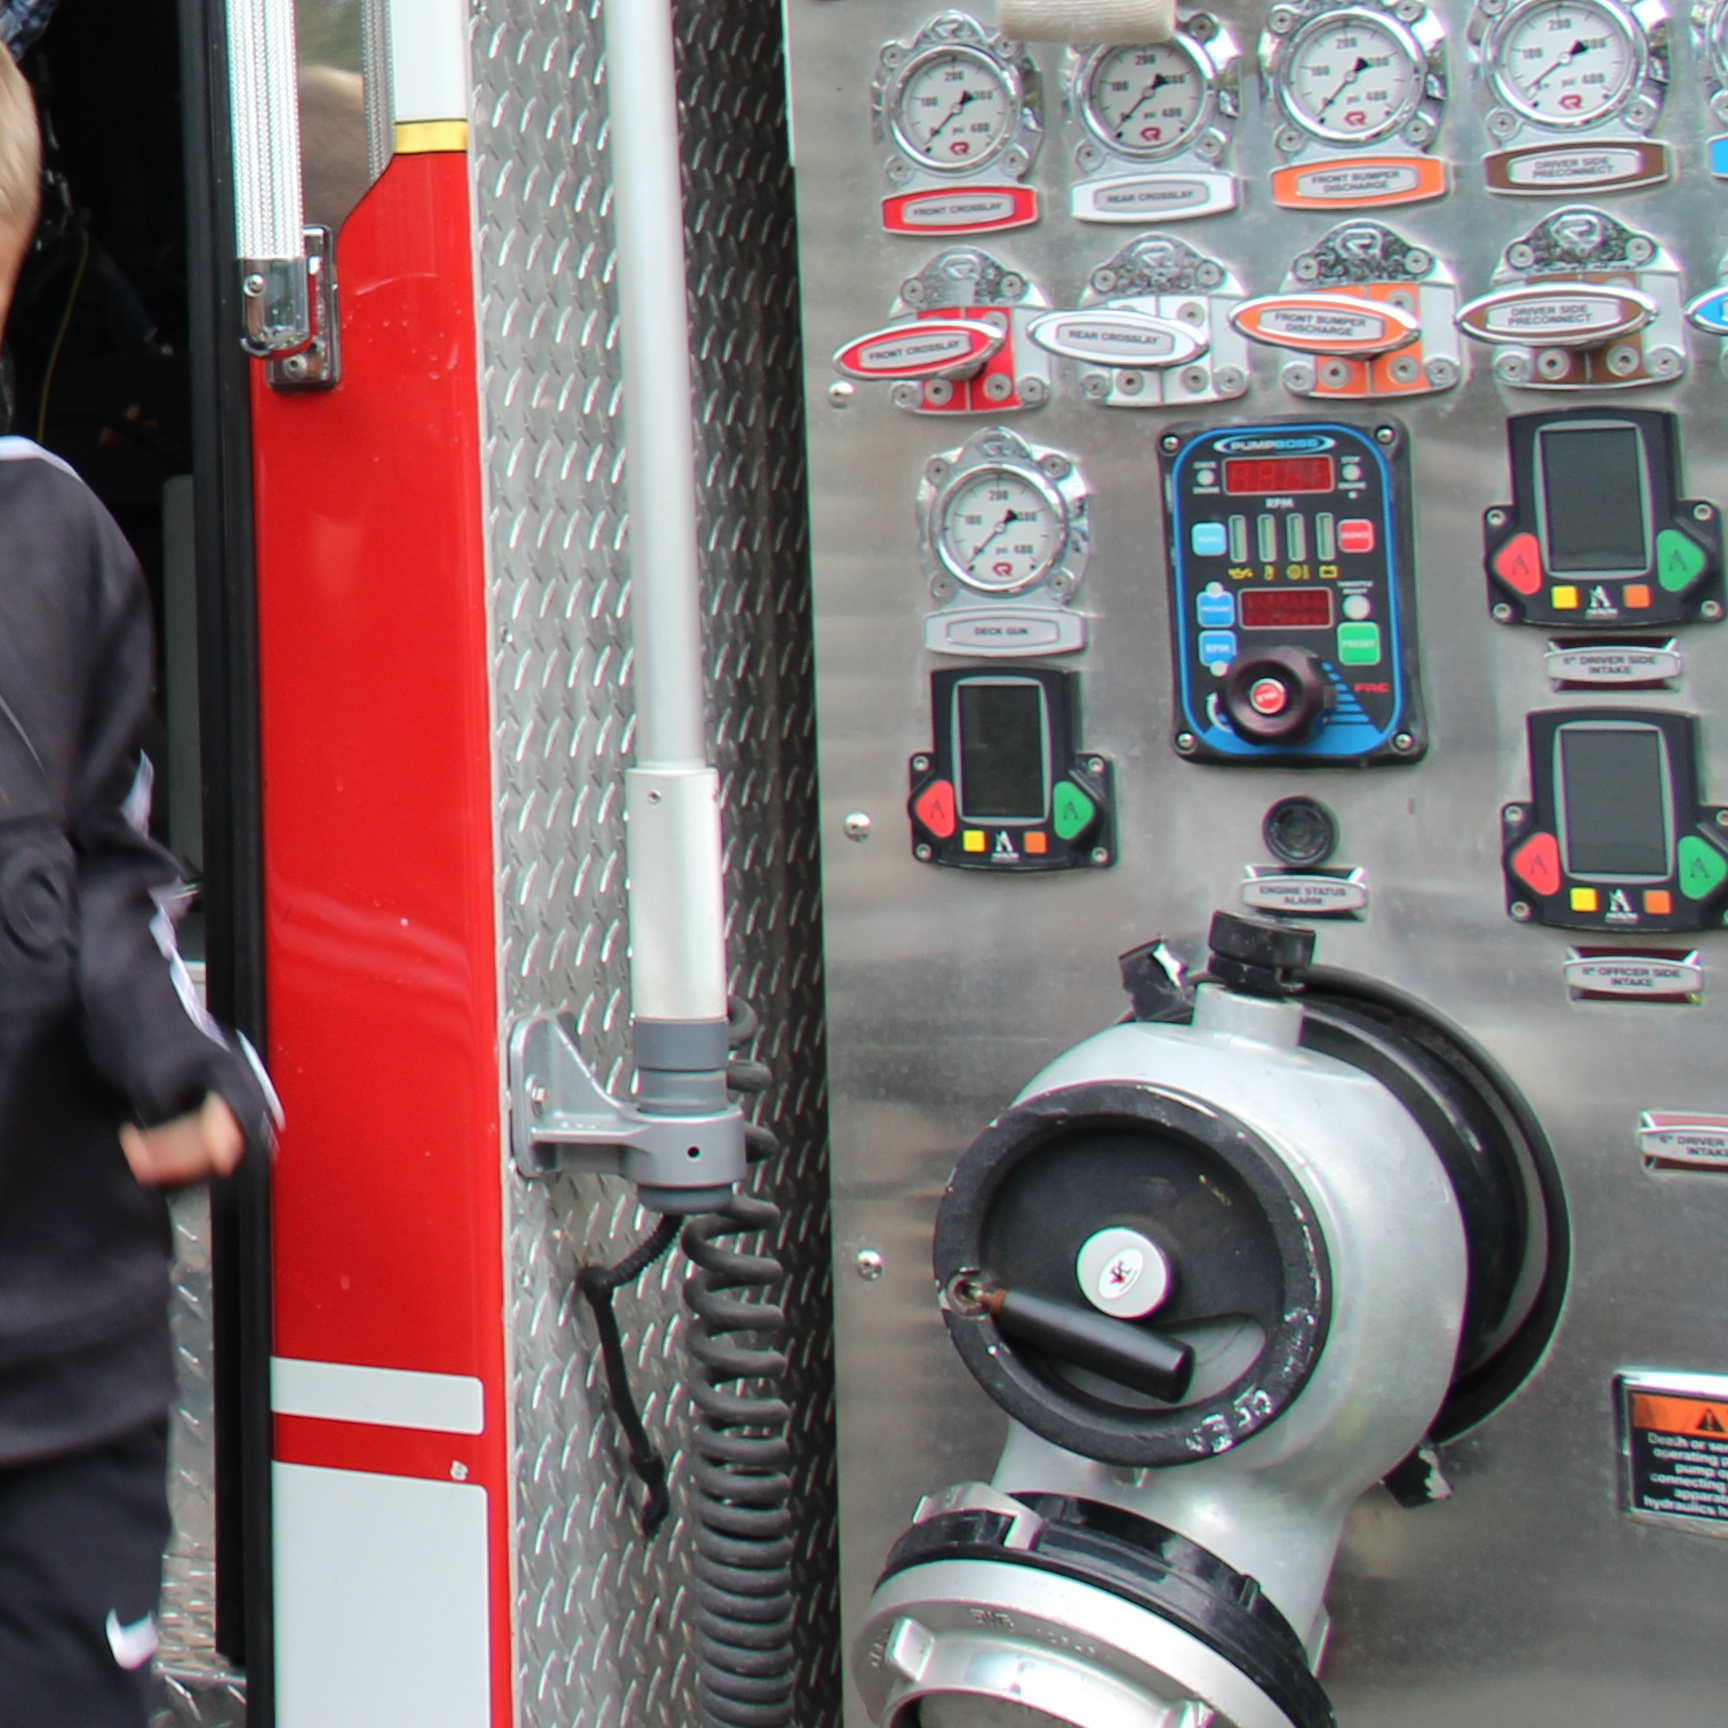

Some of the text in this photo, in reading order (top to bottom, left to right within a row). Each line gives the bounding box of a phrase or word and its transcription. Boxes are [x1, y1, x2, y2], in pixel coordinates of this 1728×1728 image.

[1534, 158, 1579, 169] DRIVER
[1311, 170, 1401, 184] FRONT BUMPER
[1532, 165, 1613, 178] PRECONNECT
[1323, 181, 1388, 192] DISCHARGE
[1107, 191, 1194, 203] REAR CROSSLAY
[914, 202, 1002, 216] FRONT CROSSLAY
[1510, 304, 1589, 316] DRIVER SIDE
[1274, 312, 1367, 326] FRONT BUMPER
[1508, 313, 1592, 326] PRECONNECT
[1285, 323, 1353, 335] DISCHARGE
[1069, 329, 1160, 344] REAR CROSSLAY
[869, 340, 960, 361] FRONT CROSSLAY
[989, 490, 1009, 501] 200
[1265, 497, 1294, 509] RPM
[974, 627, 1029, 636] DECK GUN
[1580, 656, 1624, 665] DRIVER
[1629, 656, 1657, 664] SIDE
[1588, 665, 1632, 675] INTAKE
[1259, 885, 1347, 896] ENGINE STATUS
[1284, 895, 1322, 904] ALARM
[1598, 966, 1649, 976] OFFICER
[1653, 968, 1681, 978] SIDE
[1610, 977, 1653, 987] INTAKE
[1677, 1136, 1726, 1147] DRIVER
[1647, 1432, 1689, 1449] Death
[1690, 1439, 1706, 1451] or
[1653, 1447, 1719, 1467] operating
[1675, 1463, 1715, 1478] pump
[1649, 1473, 1727, 1493] connecting
[1643, 1494, 1716, 1515] hydraulics
